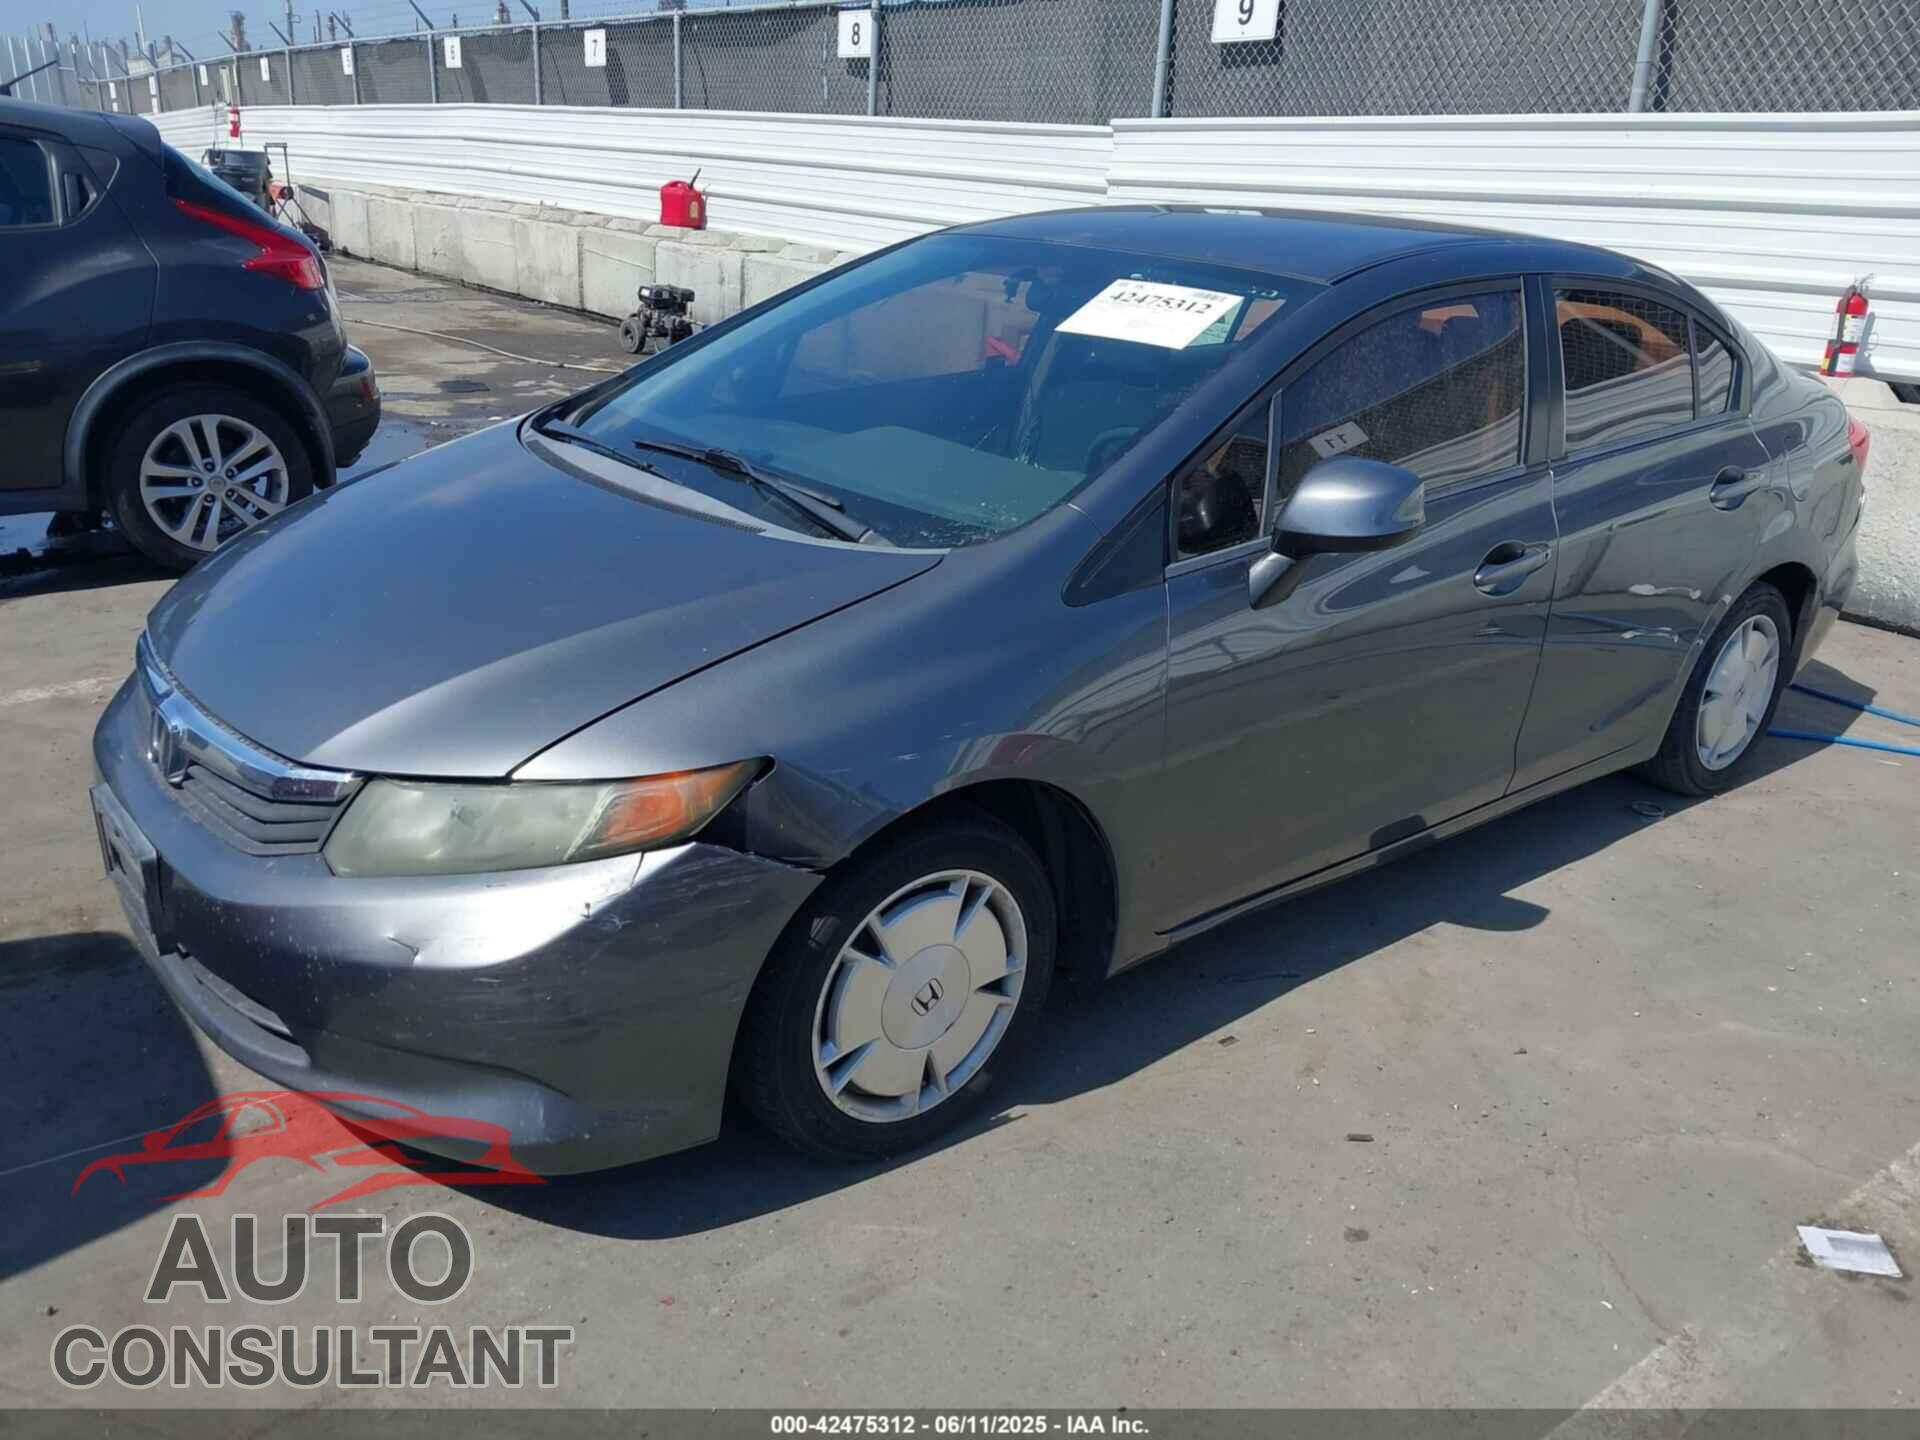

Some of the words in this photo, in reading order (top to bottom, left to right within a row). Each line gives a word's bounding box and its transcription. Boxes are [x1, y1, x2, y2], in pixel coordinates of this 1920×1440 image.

[1238, 0, 1254, 26] 9
[851, 22, 861, 46] 8
[1109, 291, 1213, 314] 42475312
